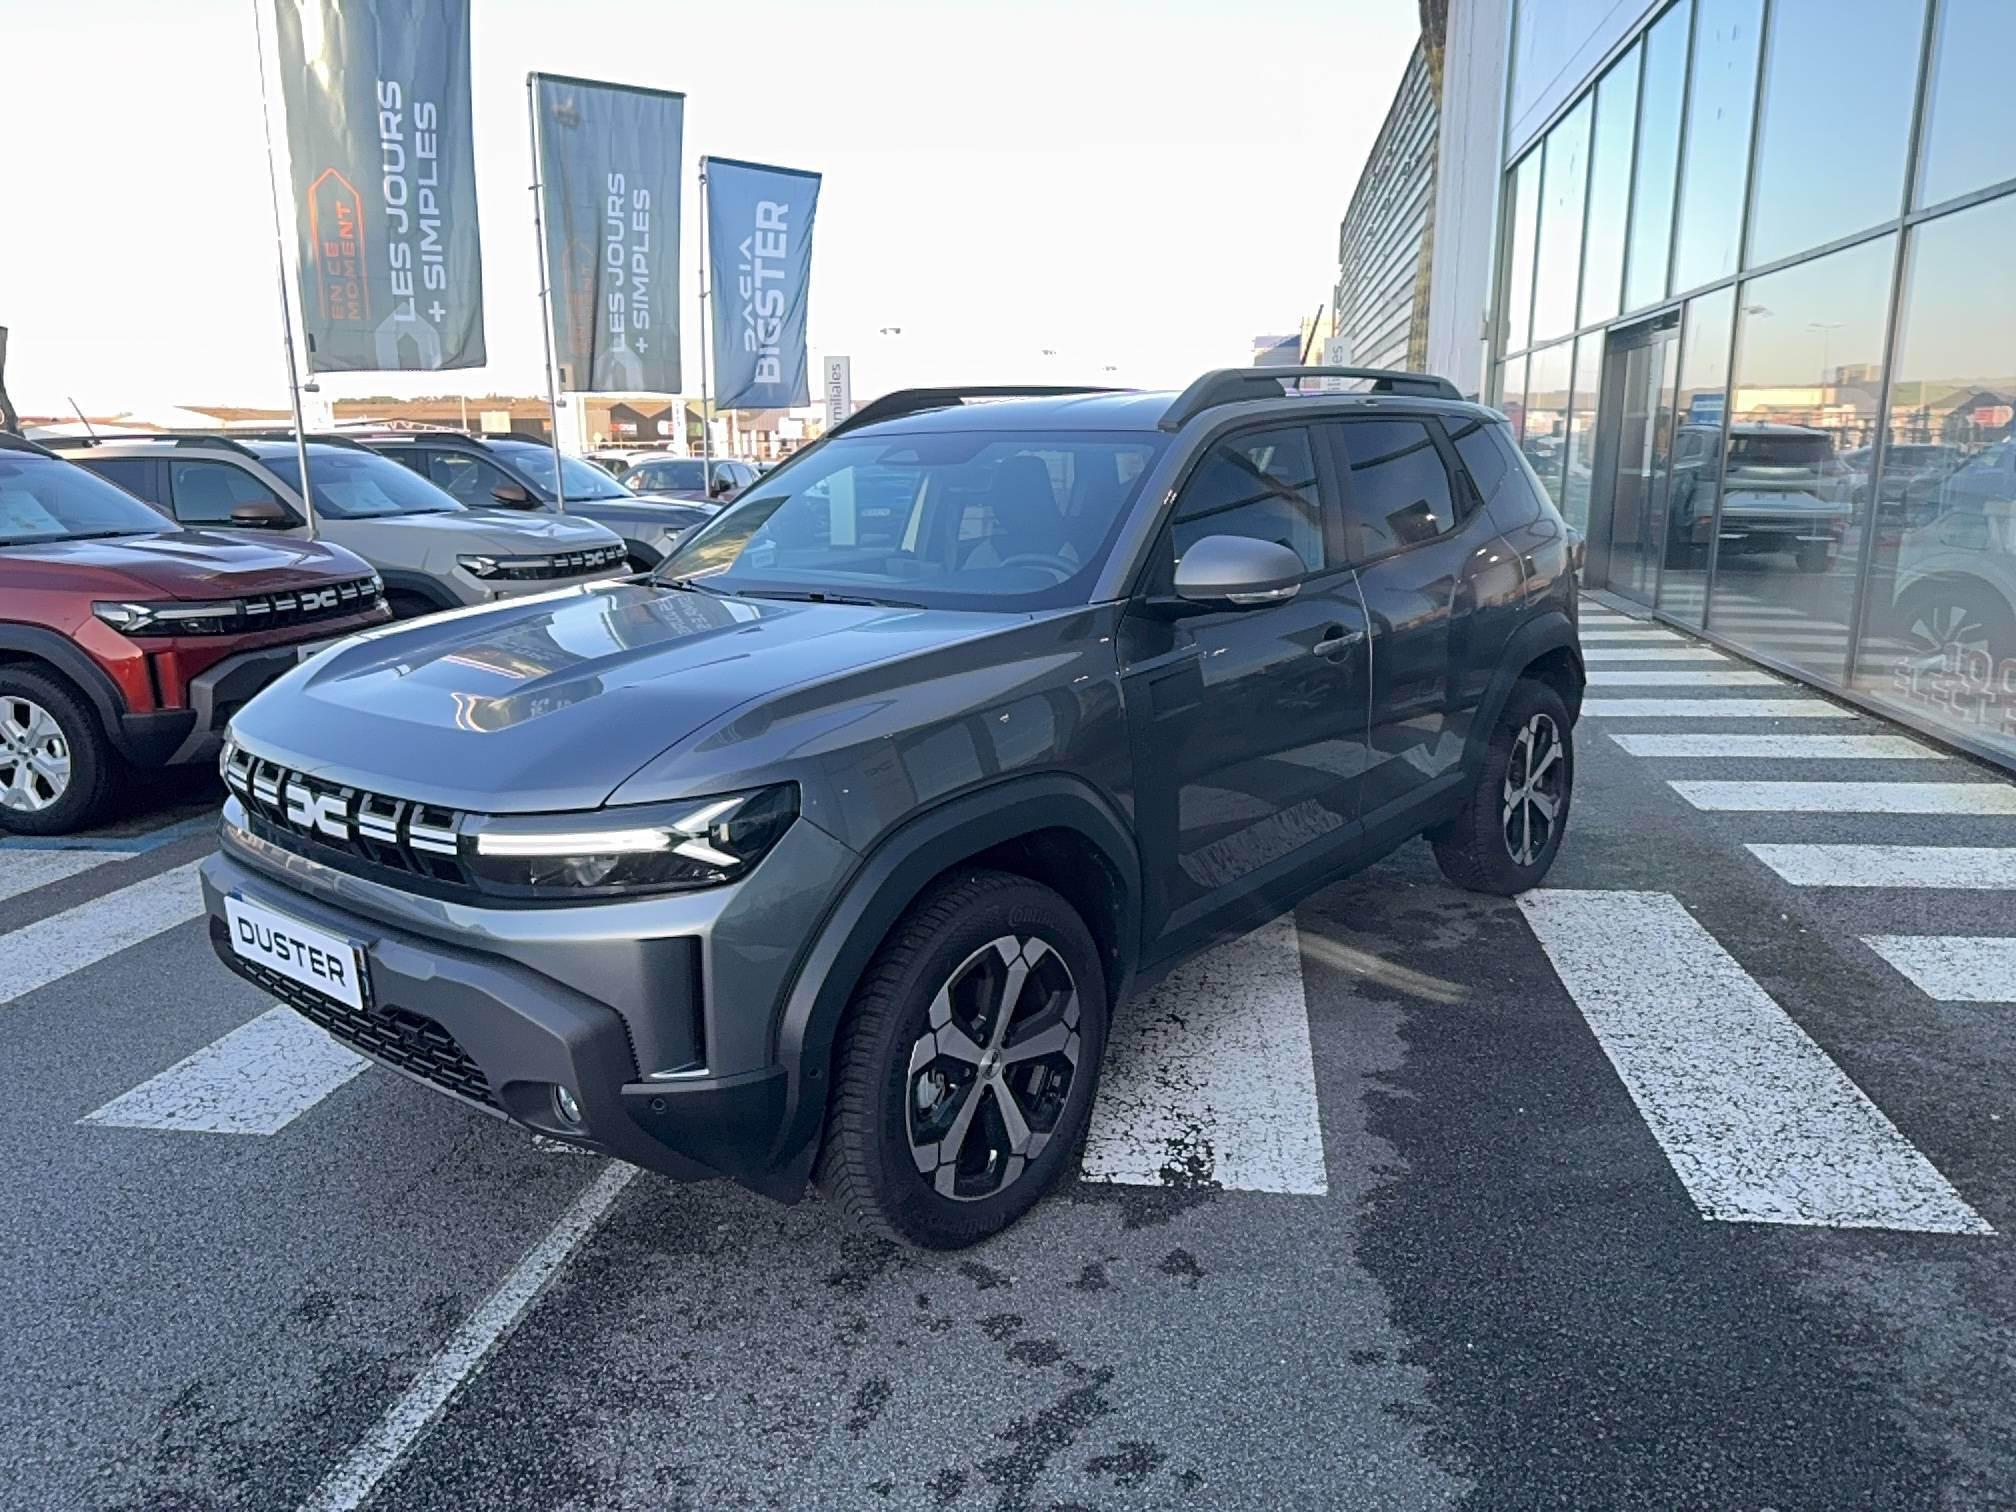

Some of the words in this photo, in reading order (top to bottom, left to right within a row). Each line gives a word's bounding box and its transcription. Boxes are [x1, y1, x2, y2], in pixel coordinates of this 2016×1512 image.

[378, 80, 410, 235] JOURS
[414, 102, 447, 290] SIMPLES
[336, 200, 361, 320] MOMENT
[389, 243, 417, 322] LES
[607, 173, 625, 287] JOURS
[633, 190, 651, 329] SIMPLES
[330, 283, 345, 320] EN
[608, 292, 625, 353] LES
[754, 201, 789, 383] BIGSTER
[237, 916, 346, 987] DUSTER
